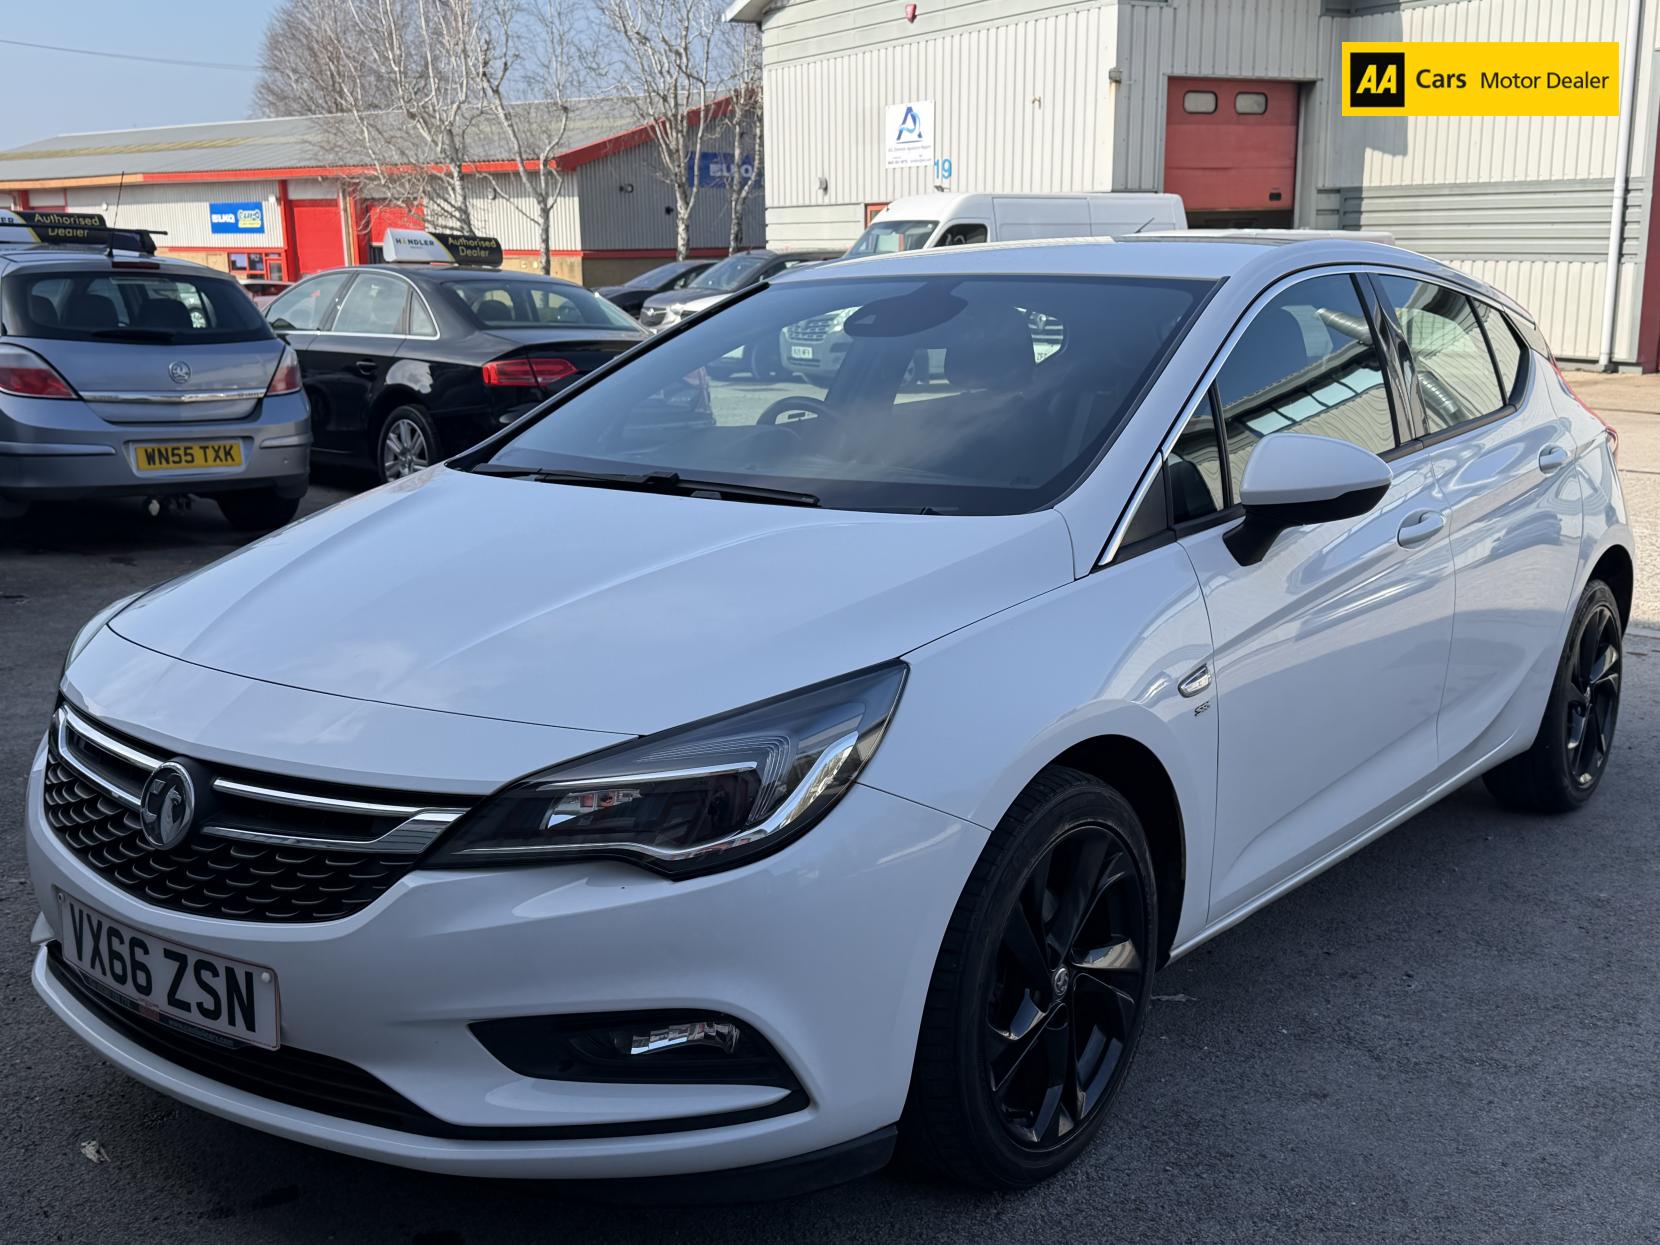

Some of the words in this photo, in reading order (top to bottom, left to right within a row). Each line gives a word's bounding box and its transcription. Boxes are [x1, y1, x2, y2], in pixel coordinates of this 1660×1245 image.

[934, 158, 952, 179] 19
[34, 213, 100, 226] Authorised
[48, 227, 89, 238] Dealer
[447, 237, 497, 249] Authorised
[458, 246, 490, 257] Dealer
[144, 446, 196, 466] WN55
[199, 444, 236, 463] TXK
[69, 902, 153, 997] VX66
[163, 947, 257, 1034] ZSN
